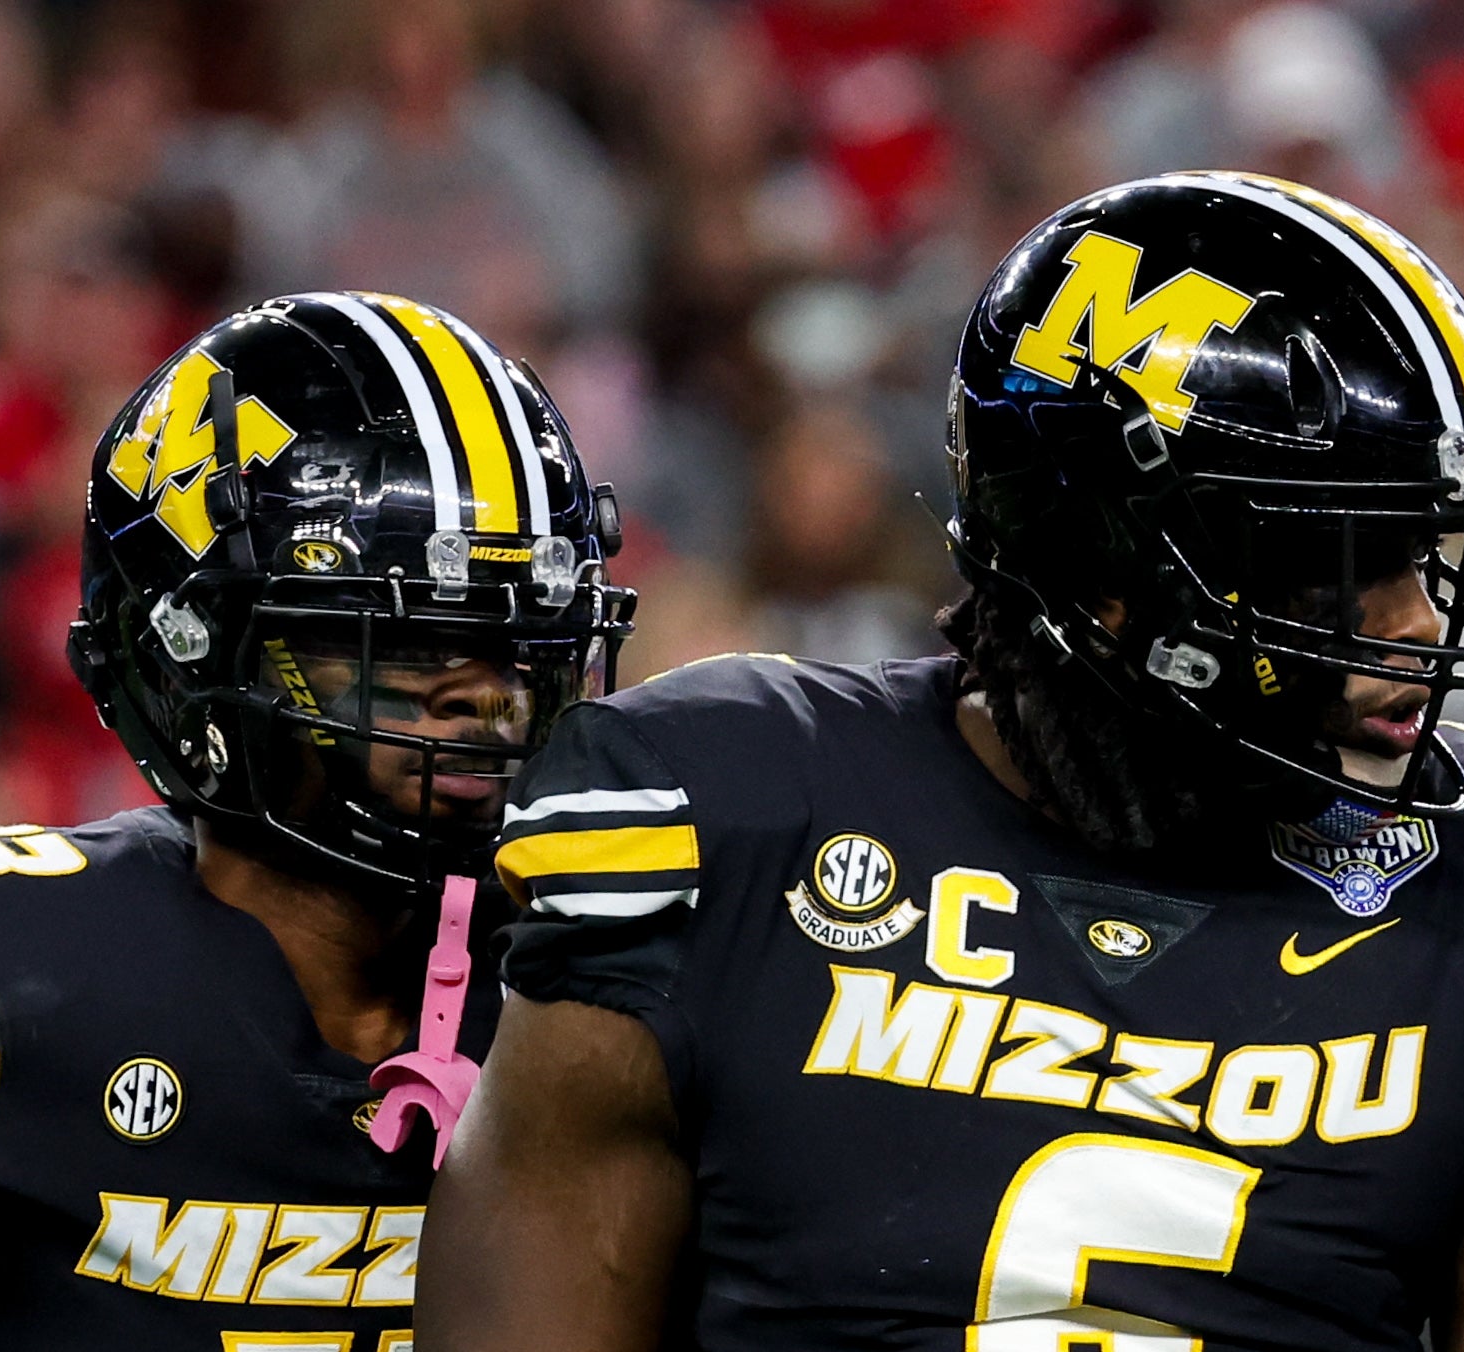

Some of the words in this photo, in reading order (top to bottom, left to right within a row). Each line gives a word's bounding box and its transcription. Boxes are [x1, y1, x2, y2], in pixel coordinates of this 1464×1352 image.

[1011, 230, 1256, 435] M
[107, 348, 298, 561] M
[469, 545, 532, 563] MIZZOU
[821, 838, 890, 906] SEC
[1315, 846, 1399, 870] BOWL
[1334, 864, 1385, 886] CLASSIC
[798, 906, 901, 948] GRADUATE
[924, 865, 1020, 988] C
[802, 963, 1428, 1147] MIZZOU
[110, 1062, 177, 1135] SEC
